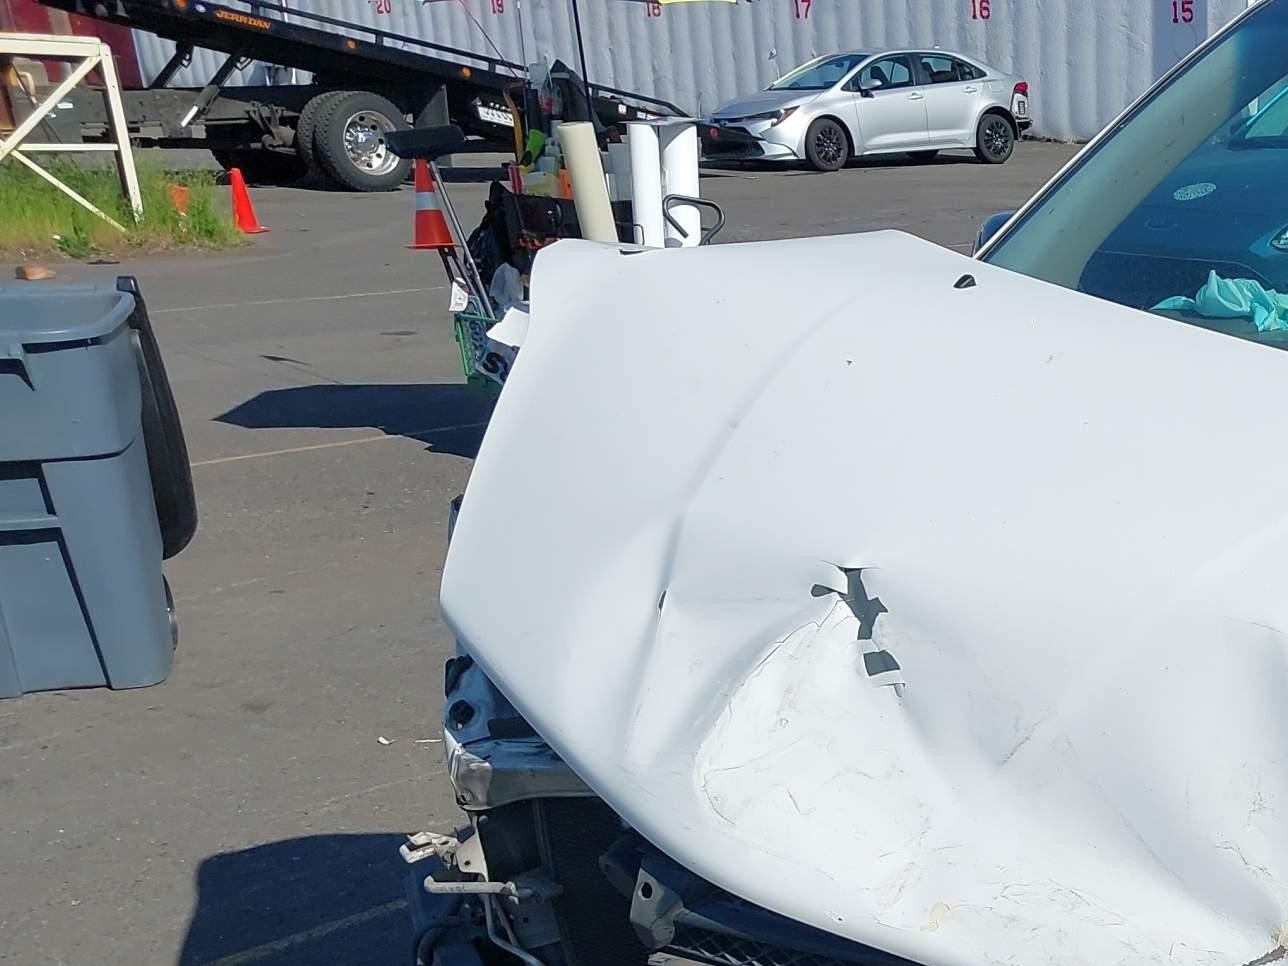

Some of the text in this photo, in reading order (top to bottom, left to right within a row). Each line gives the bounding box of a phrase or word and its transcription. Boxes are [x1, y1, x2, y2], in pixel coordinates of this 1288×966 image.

[794, 0, 811, 18] 17
[970, 0, 990, 19] 16
[1172, 1, 1194, 23] 15
